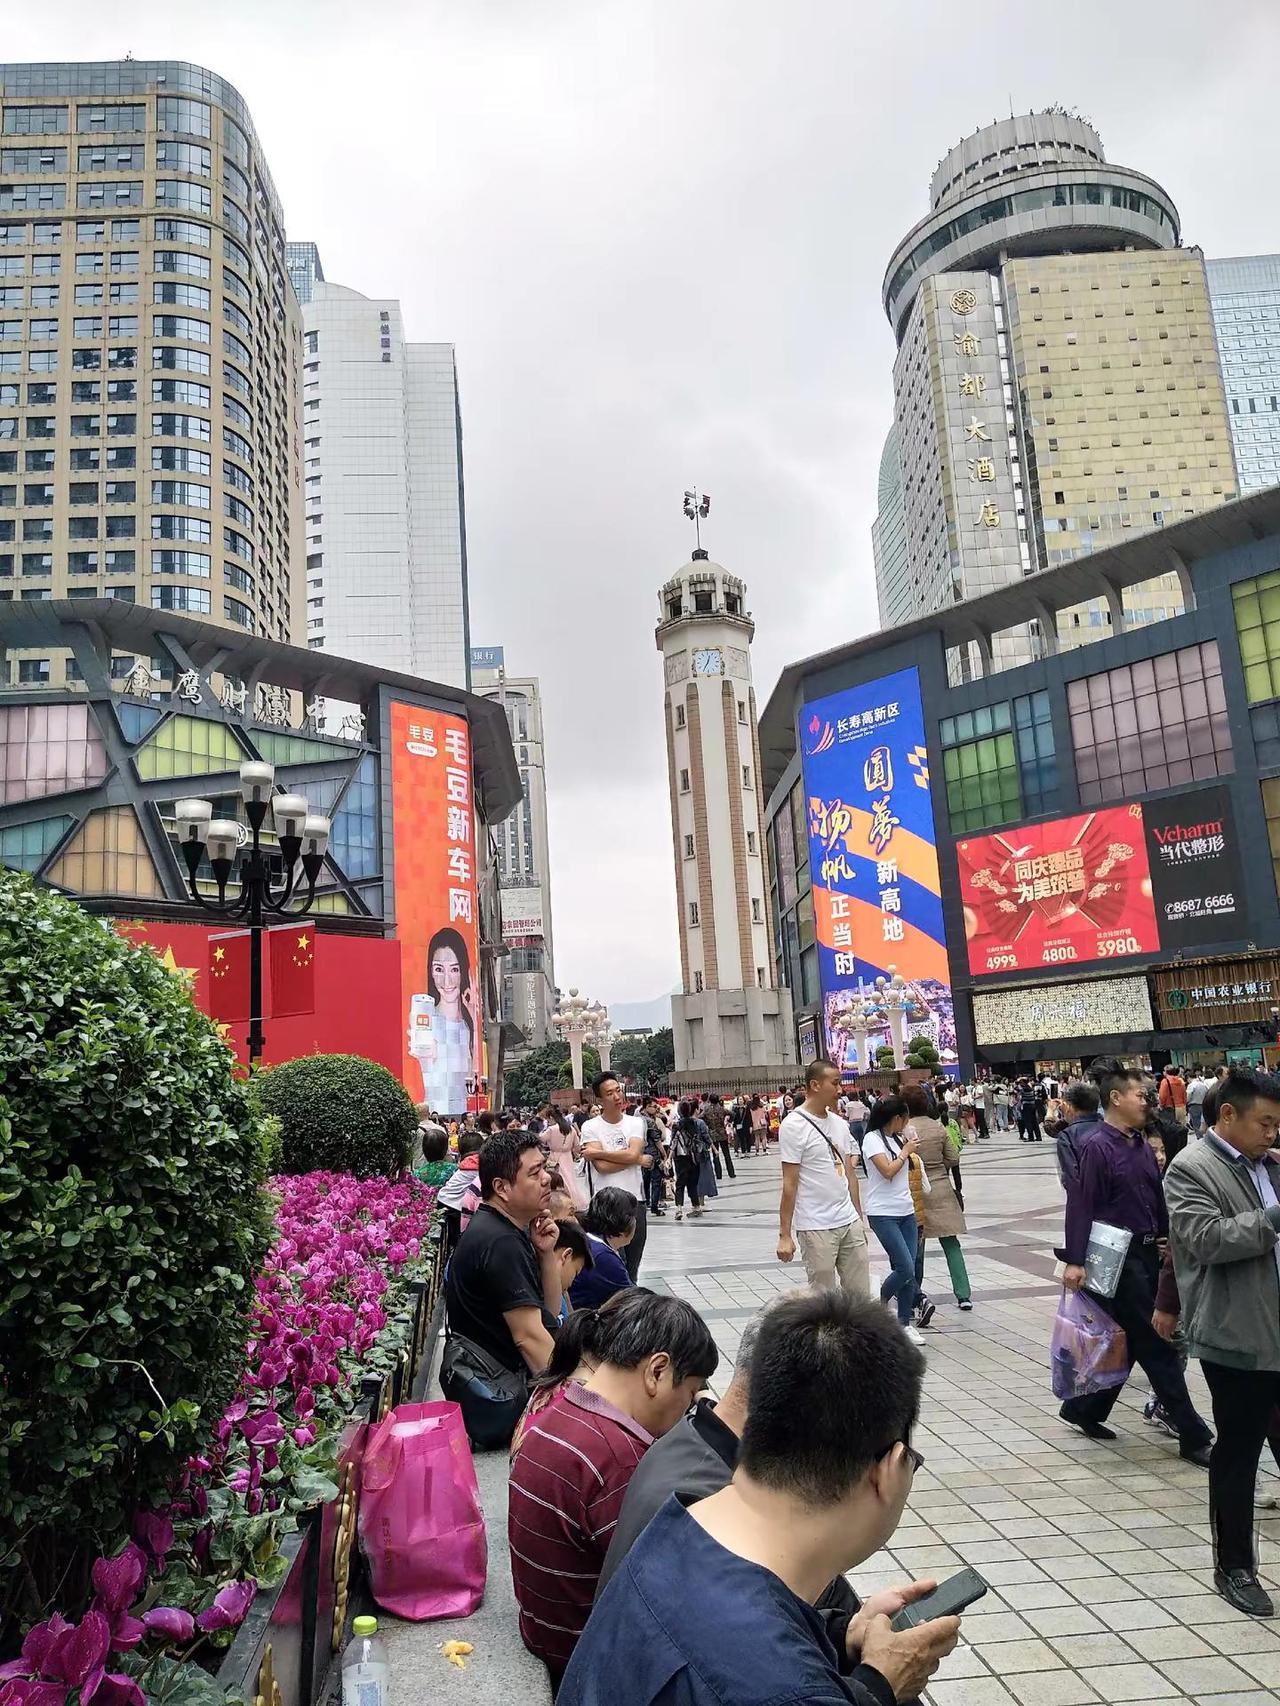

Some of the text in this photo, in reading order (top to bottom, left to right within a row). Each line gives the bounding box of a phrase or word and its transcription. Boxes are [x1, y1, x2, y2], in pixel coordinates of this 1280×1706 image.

[954, 330, 1000, 528] 渝都大酒店
[837, 702, 900, 733] 长寿高新区
[408, 723, 435, 743] 毛豆
[444, 728, 472, 923] 毛豆新车网
[1152, 820, 1222, 844] Vcharm
[1160, 834, 1225, 861] 当代整形
[1173, 898, 1202, 914] 8687
[1204, 893, 1235, 909] 6666
[1191, 981, 1272, 1001] 中国农业银行
